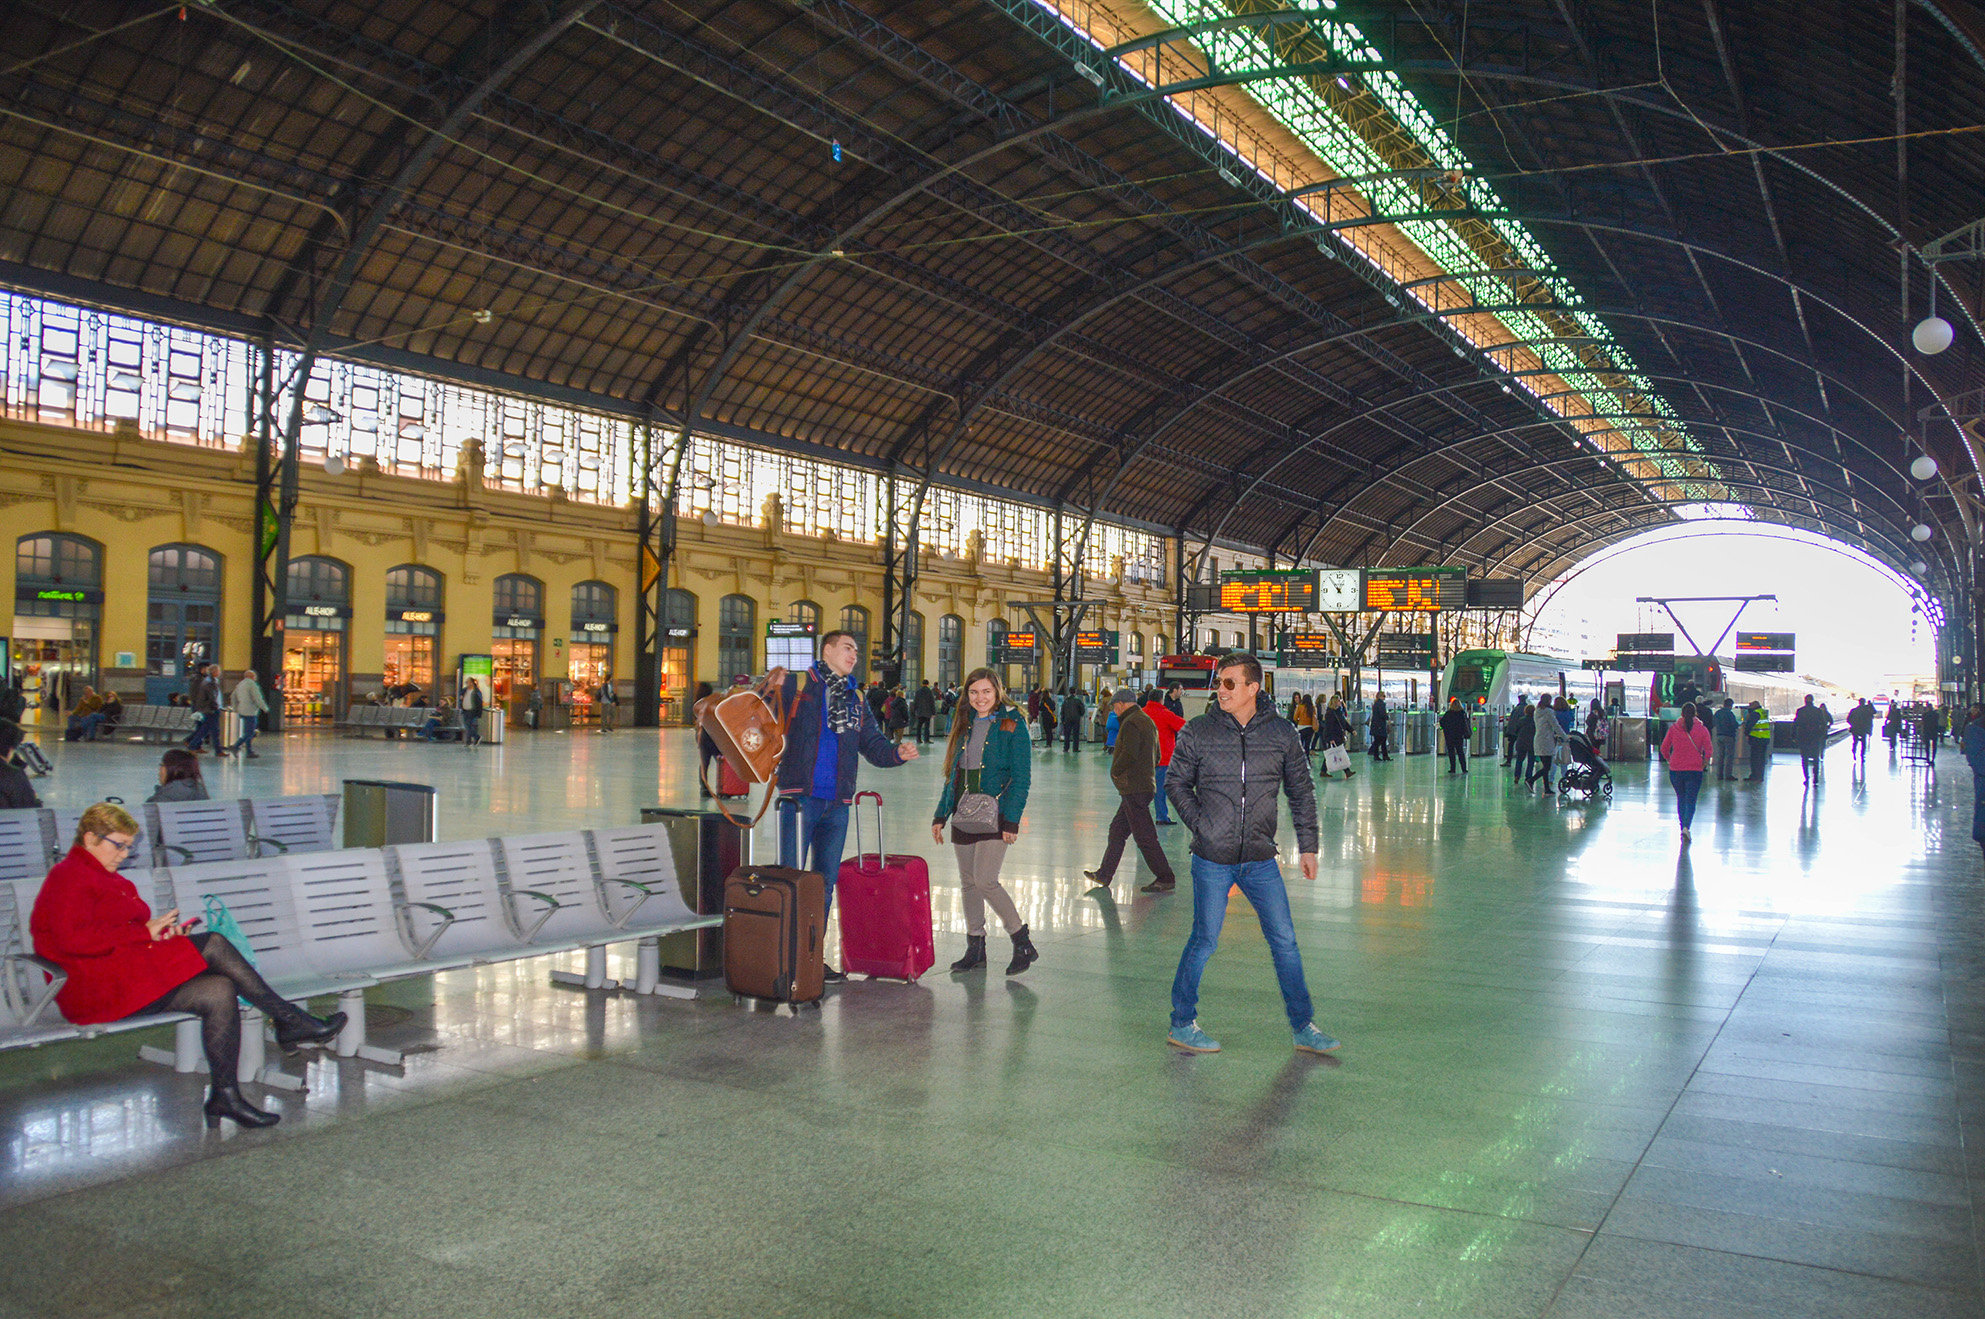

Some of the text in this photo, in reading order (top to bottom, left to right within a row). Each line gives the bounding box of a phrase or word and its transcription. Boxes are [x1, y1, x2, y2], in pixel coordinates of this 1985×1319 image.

[304, 606, 336, 616] ALE-HOP
[401, 611, 432, 622] ALE-HOP
[507, 618, 532, 627] ALE-HOP
[583, 623, 606, 631] ALE-HOP
